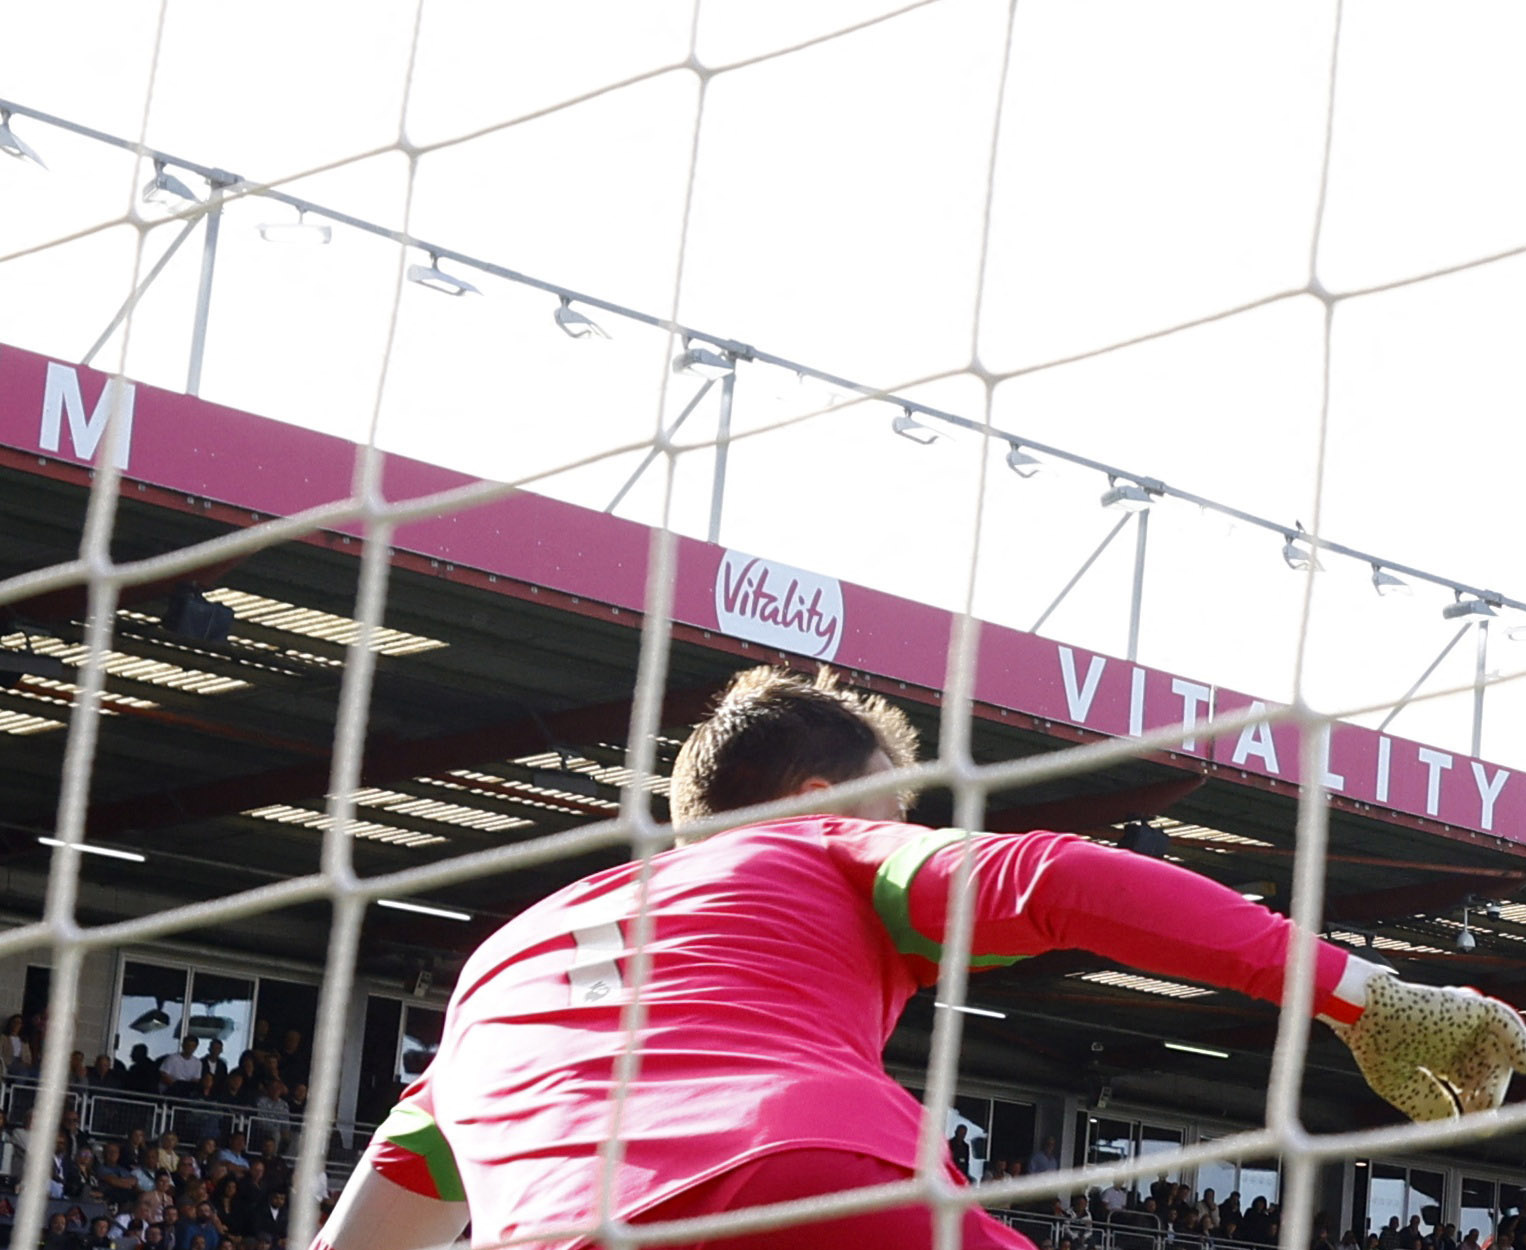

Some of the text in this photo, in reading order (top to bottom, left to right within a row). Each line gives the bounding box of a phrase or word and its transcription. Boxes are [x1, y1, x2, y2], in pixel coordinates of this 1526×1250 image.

[39, 361, 136, 470] M
[724, 557, 838, 657] Vitality
[1057, 645, 1511, 831] VITALITY
